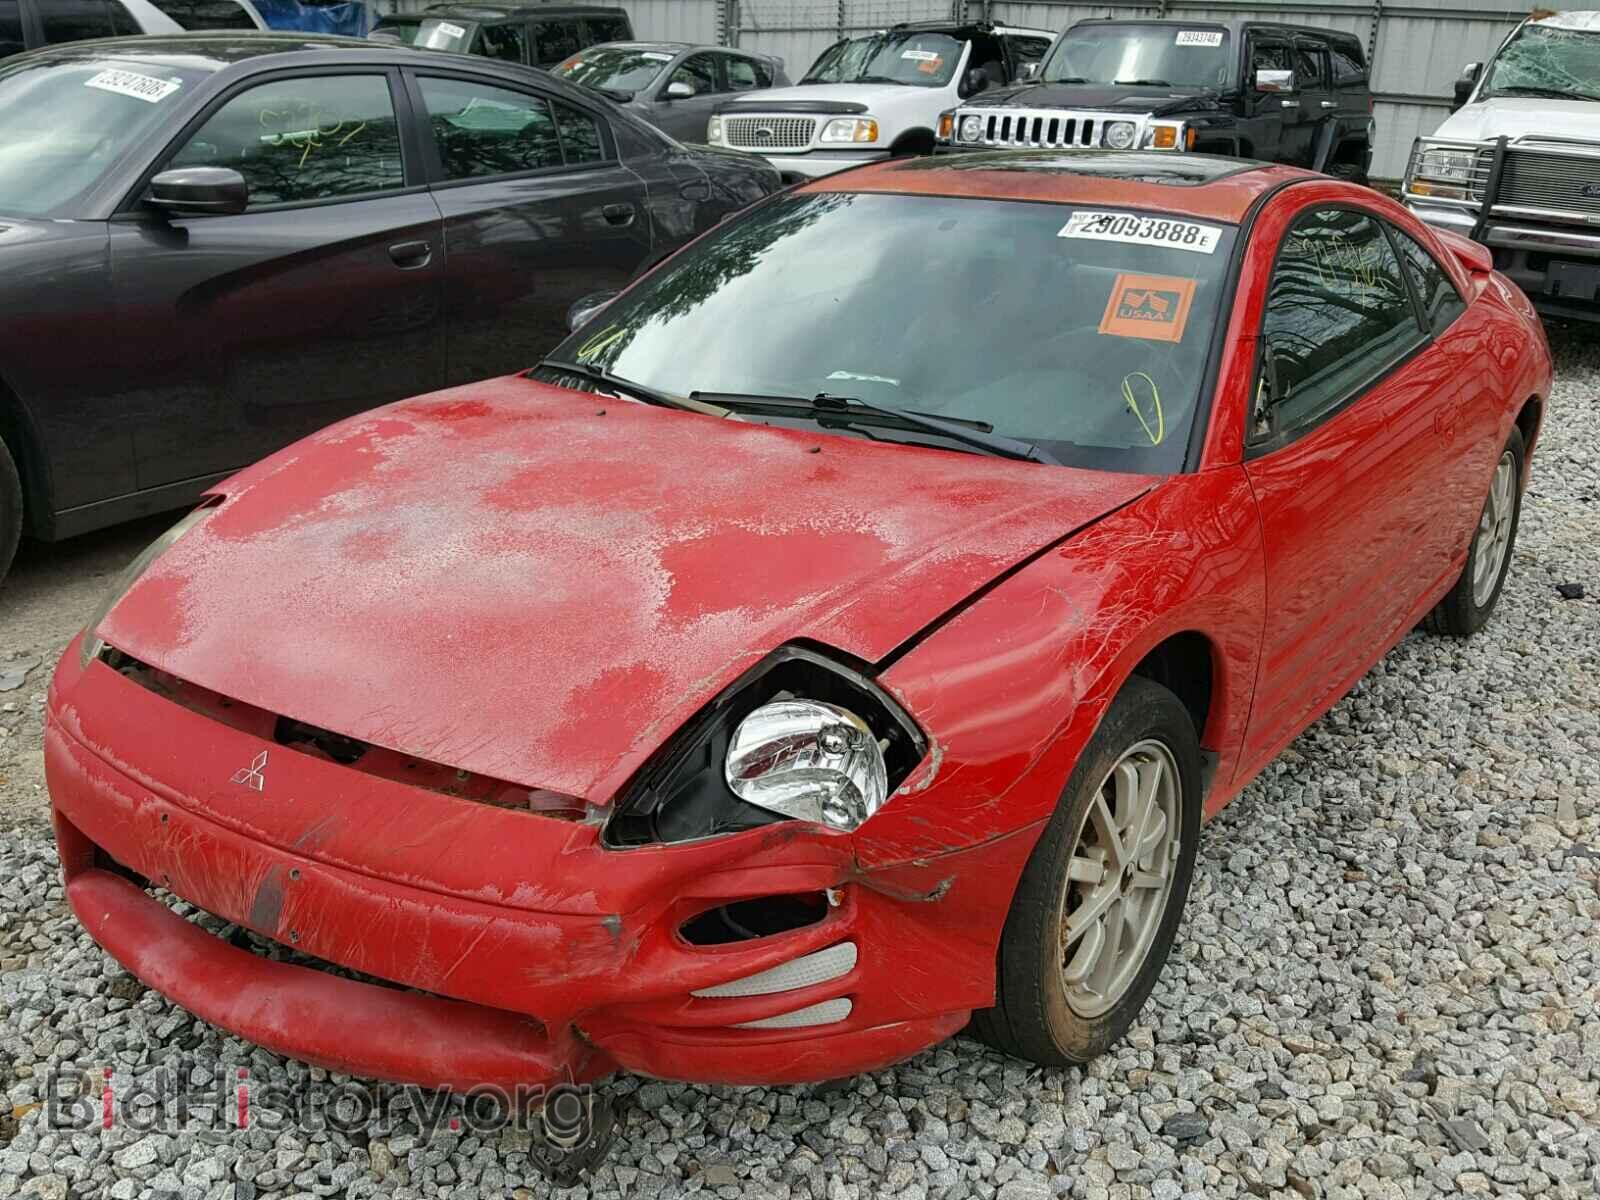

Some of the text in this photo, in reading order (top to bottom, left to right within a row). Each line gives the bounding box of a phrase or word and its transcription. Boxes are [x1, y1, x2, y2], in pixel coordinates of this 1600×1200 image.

[1080, 213, 1200, 244] 29093888
[1199, 235, 1209, 247] E
[1118, 308, 1165, 321] USAA
